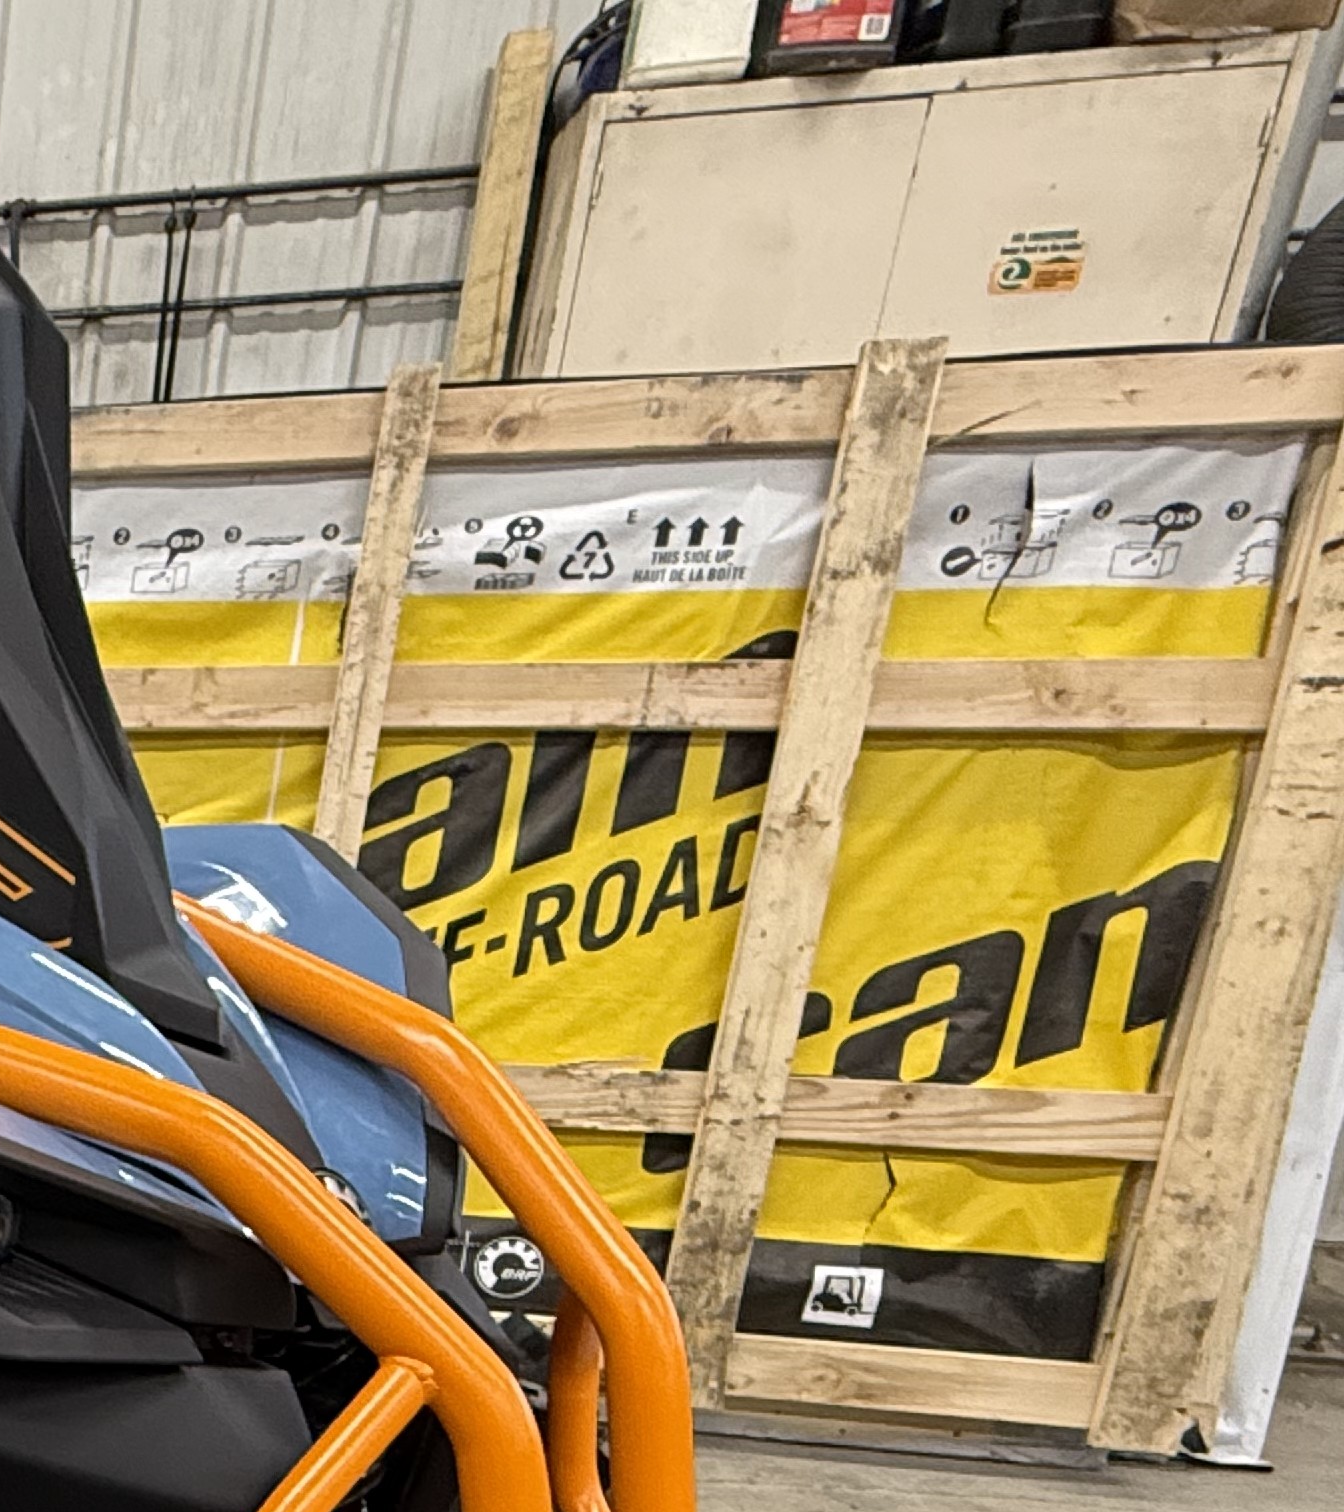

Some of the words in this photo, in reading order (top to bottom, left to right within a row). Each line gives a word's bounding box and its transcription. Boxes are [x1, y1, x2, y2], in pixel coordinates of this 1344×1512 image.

[651, 551, 681, 566] THIS
[682, 550, 712, 565] SIDE
[714, 550, 735, 564] UP
[633, 567, 666, 582] HAUT
[668, 567, 685, 582] DE
[687, 567, 705, 582] LA
